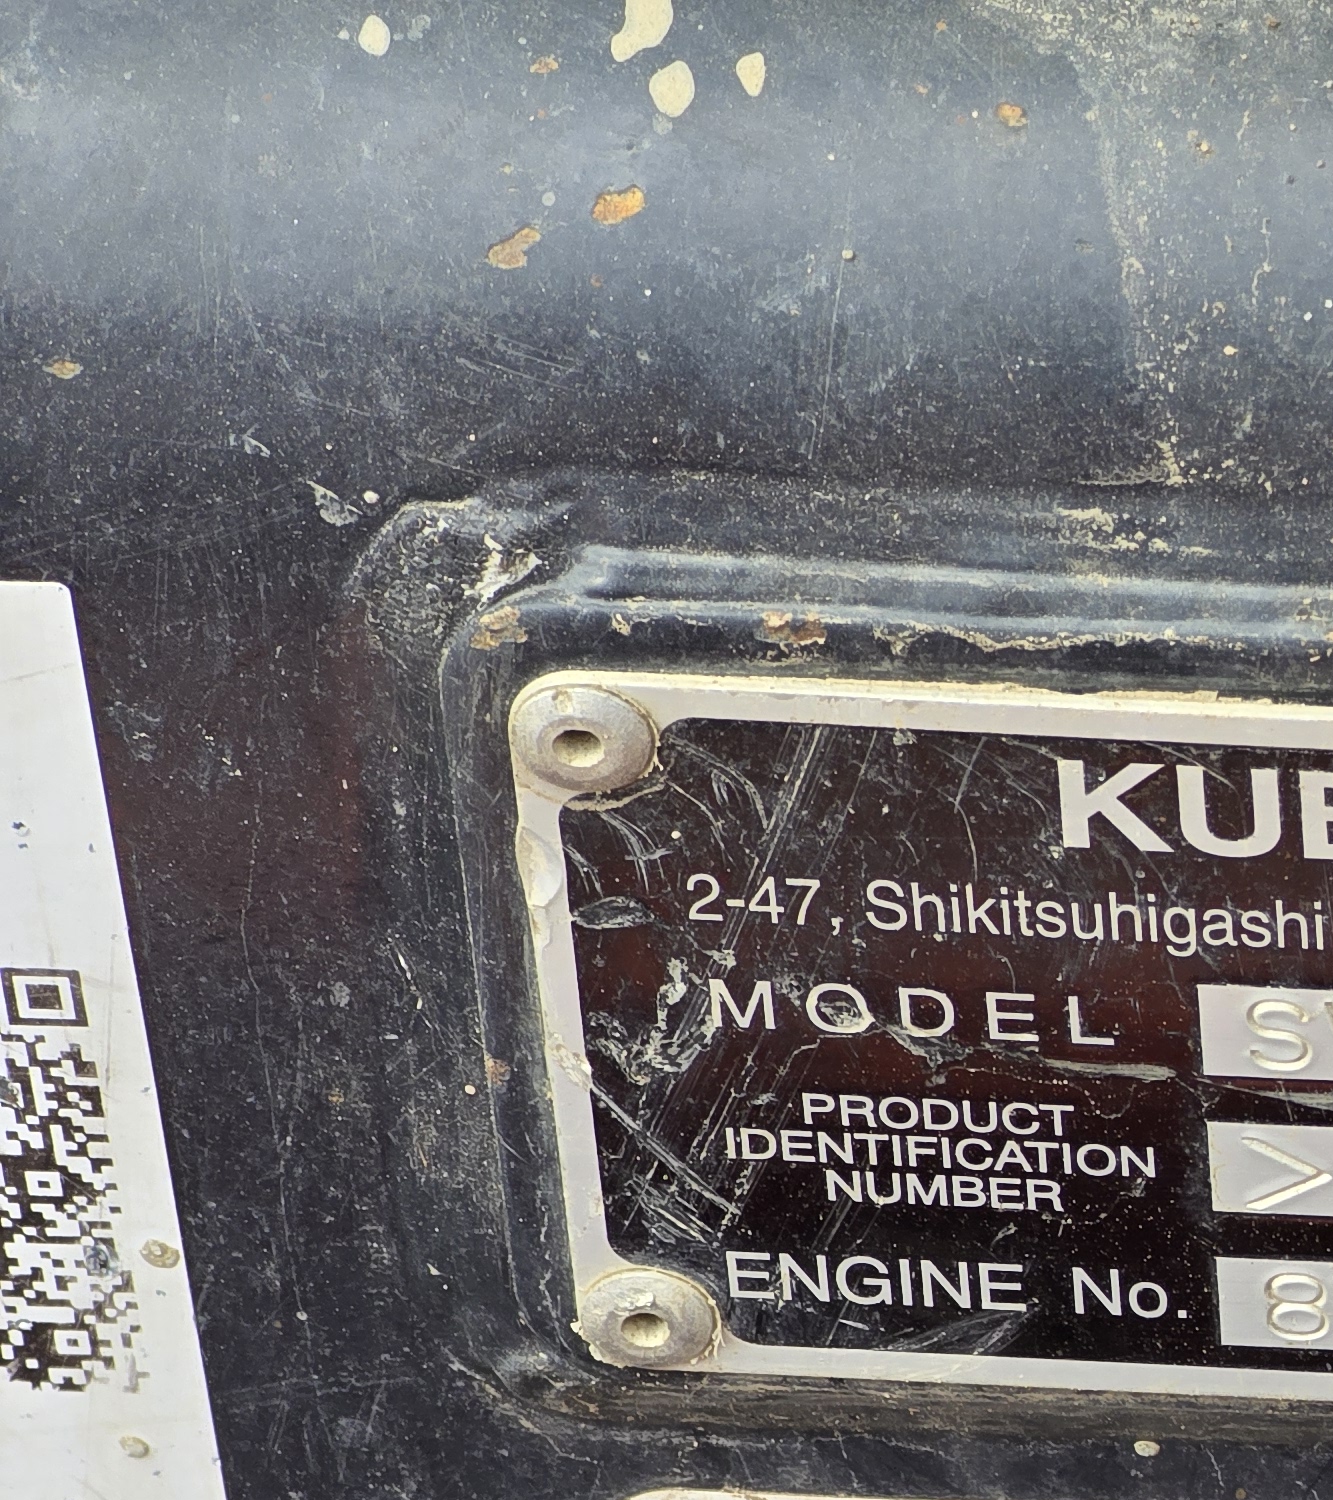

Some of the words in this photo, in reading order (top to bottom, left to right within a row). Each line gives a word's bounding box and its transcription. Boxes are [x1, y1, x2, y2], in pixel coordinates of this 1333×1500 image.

[685, 872, 844, 937] 2-47,
[865, 878, 1326, 958] Shikitsuhigashi
[708, 977, 1116, 1047] MODEL
[801, 1091, 1075, 1137] PRODUCT
[724, 1126, 1158, 1179] IDENTIFICATION
[825, 1169, 1065, 1213] NUMBER
[724, 1249, 1028, 1313] ENGINE
[1071, 1266, 1188, 1320] No.
